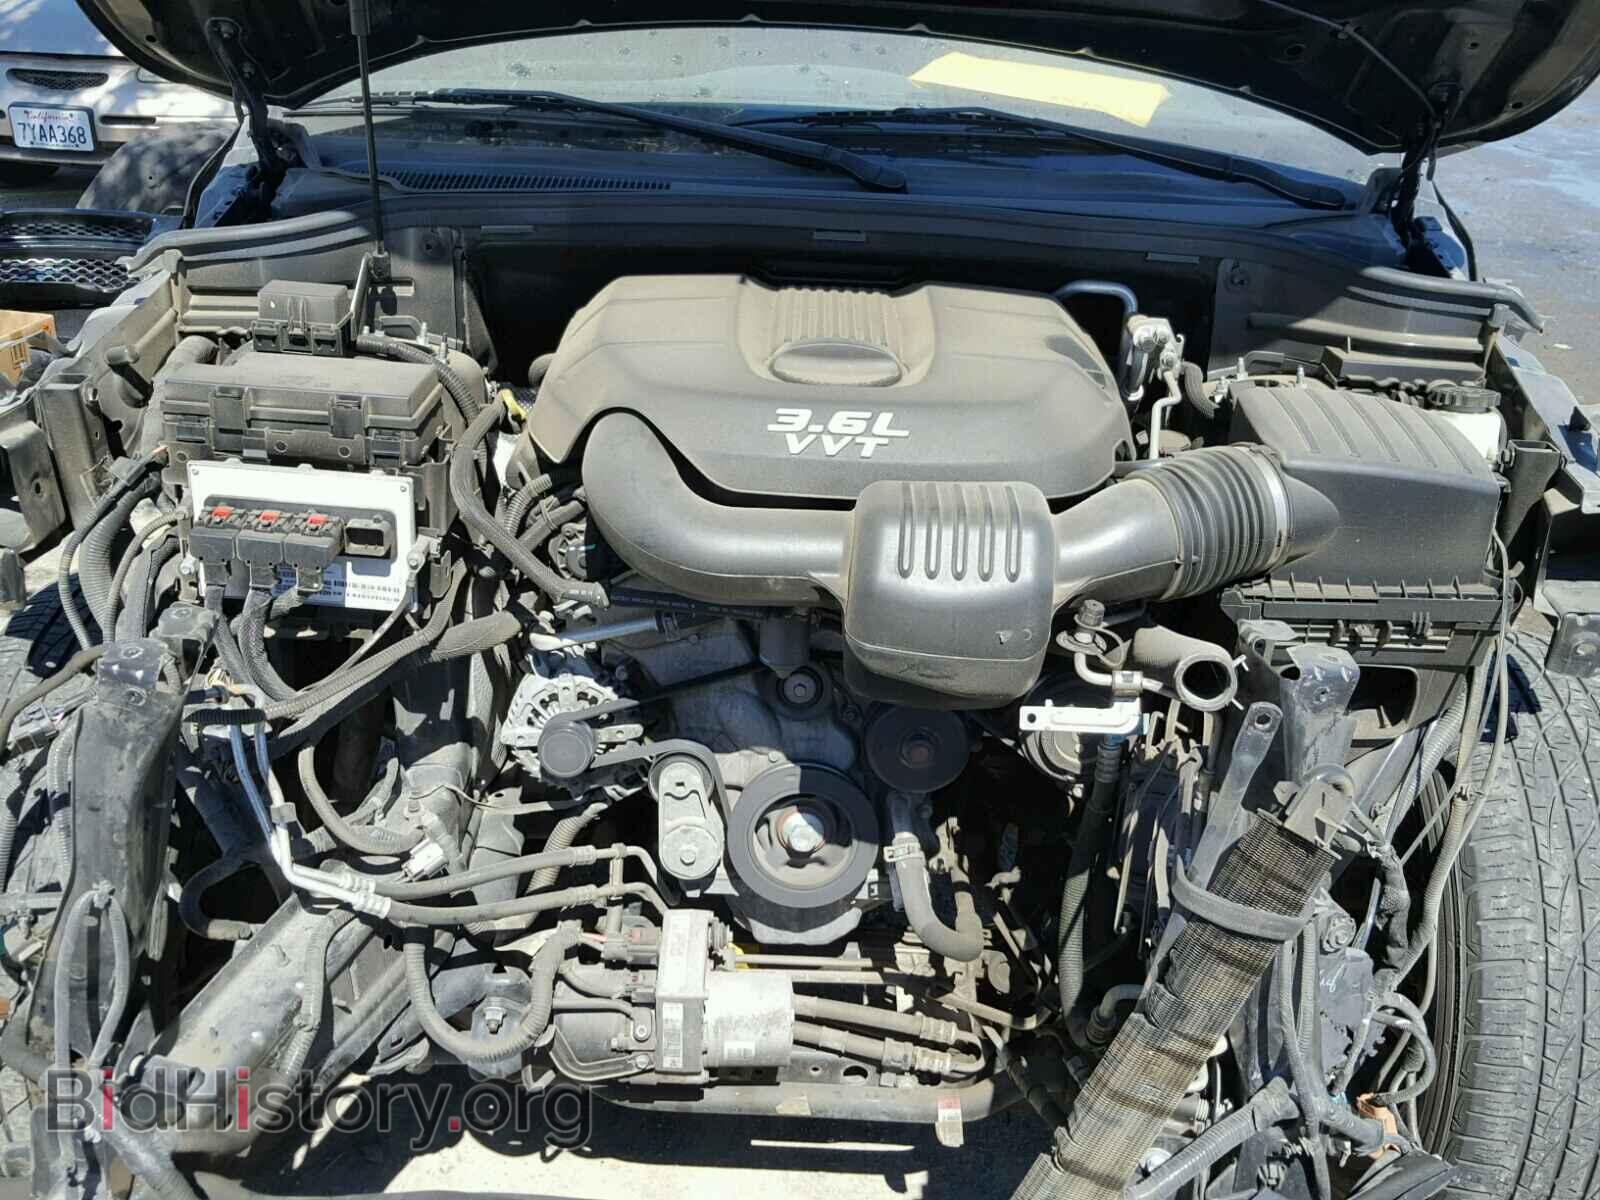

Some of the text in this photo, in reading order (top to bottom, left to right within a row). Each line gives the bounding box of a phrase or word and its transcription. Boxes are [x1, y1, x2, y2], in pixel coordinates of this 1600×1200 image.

[25, 111, 70, 122] California
[17, 122, 87, 144] 7YAA368
[767, 408, 910, 437] 3.6L
[785, 433, 889, 459] VVT
